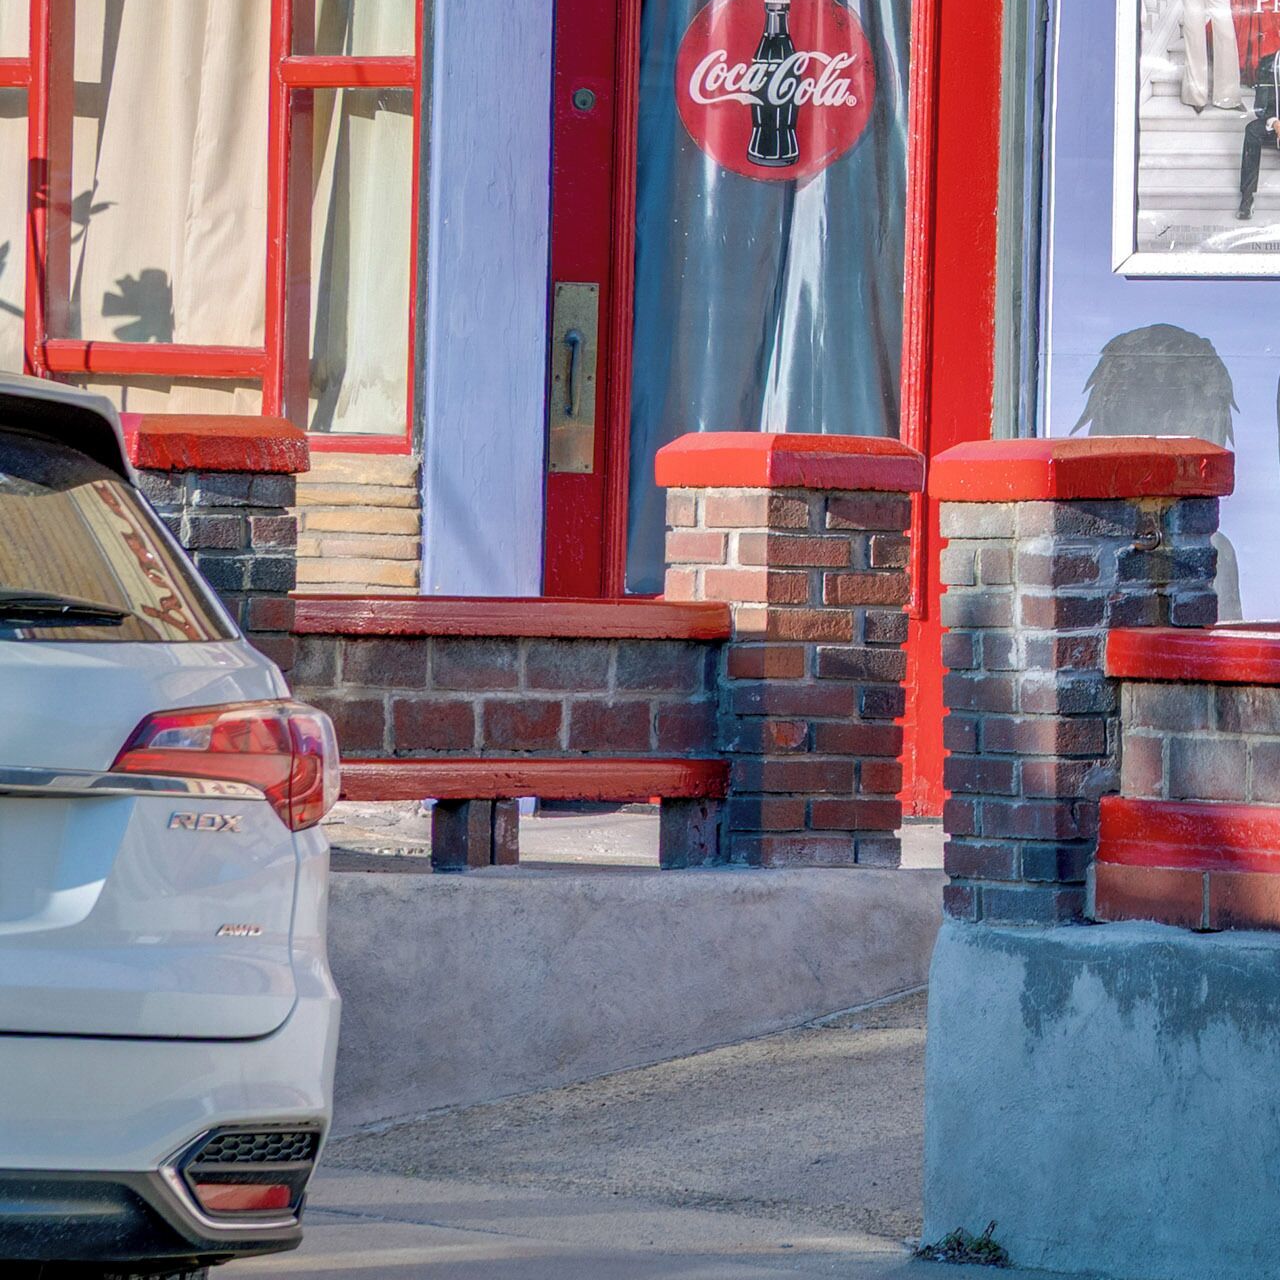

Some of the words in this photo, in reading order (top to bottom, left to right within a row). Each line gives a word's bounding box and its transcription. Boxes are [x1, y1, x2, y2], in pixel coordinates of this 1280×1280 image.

[689, 49, 857, 107] Coca-Cola
[1251, 242, 1261, 251] IN
[167, 810, 243, 832] RDX
[215, 923, 263, 936] AWD
